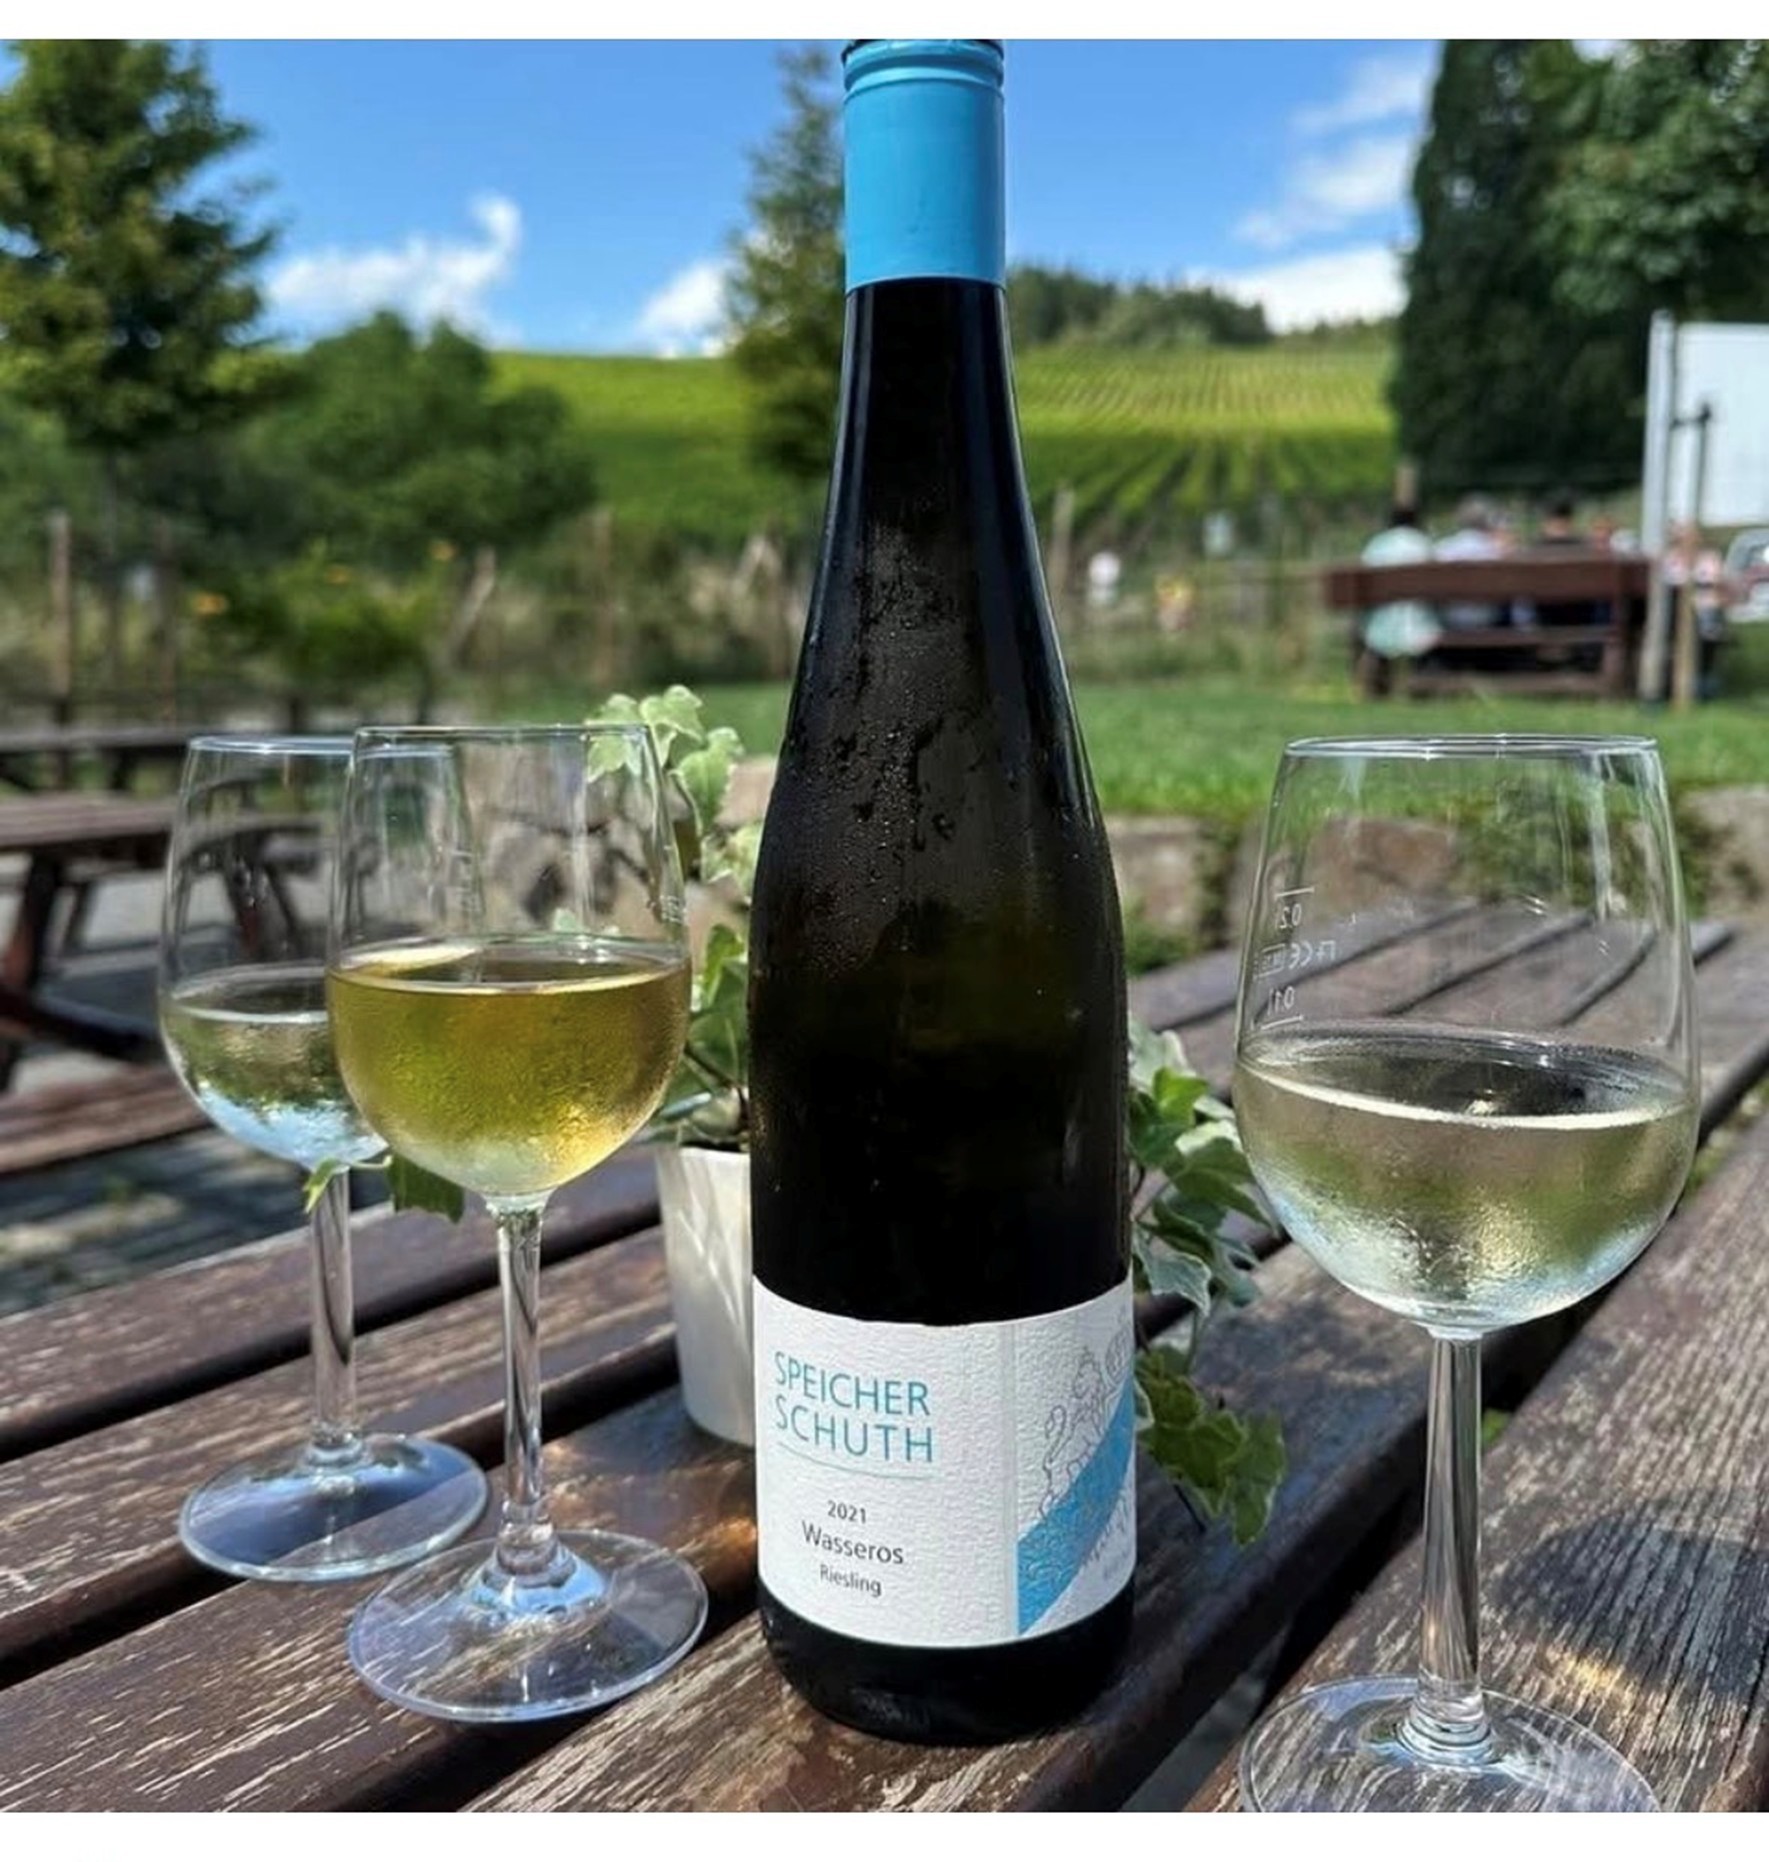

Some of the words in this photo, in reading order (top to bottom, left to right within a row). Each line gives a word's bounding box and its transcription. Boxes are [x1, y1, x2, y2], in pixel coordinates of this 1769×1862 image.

[774, 1351, 931, 1416] SPEICHER
[775, 1395, 934, 1463] SCHUTH
[827, 1500, 867, 1524] 2021
[802, 1521, 904, 1564] Wasseros
[820, 1564, 882, 1598] Riesling
